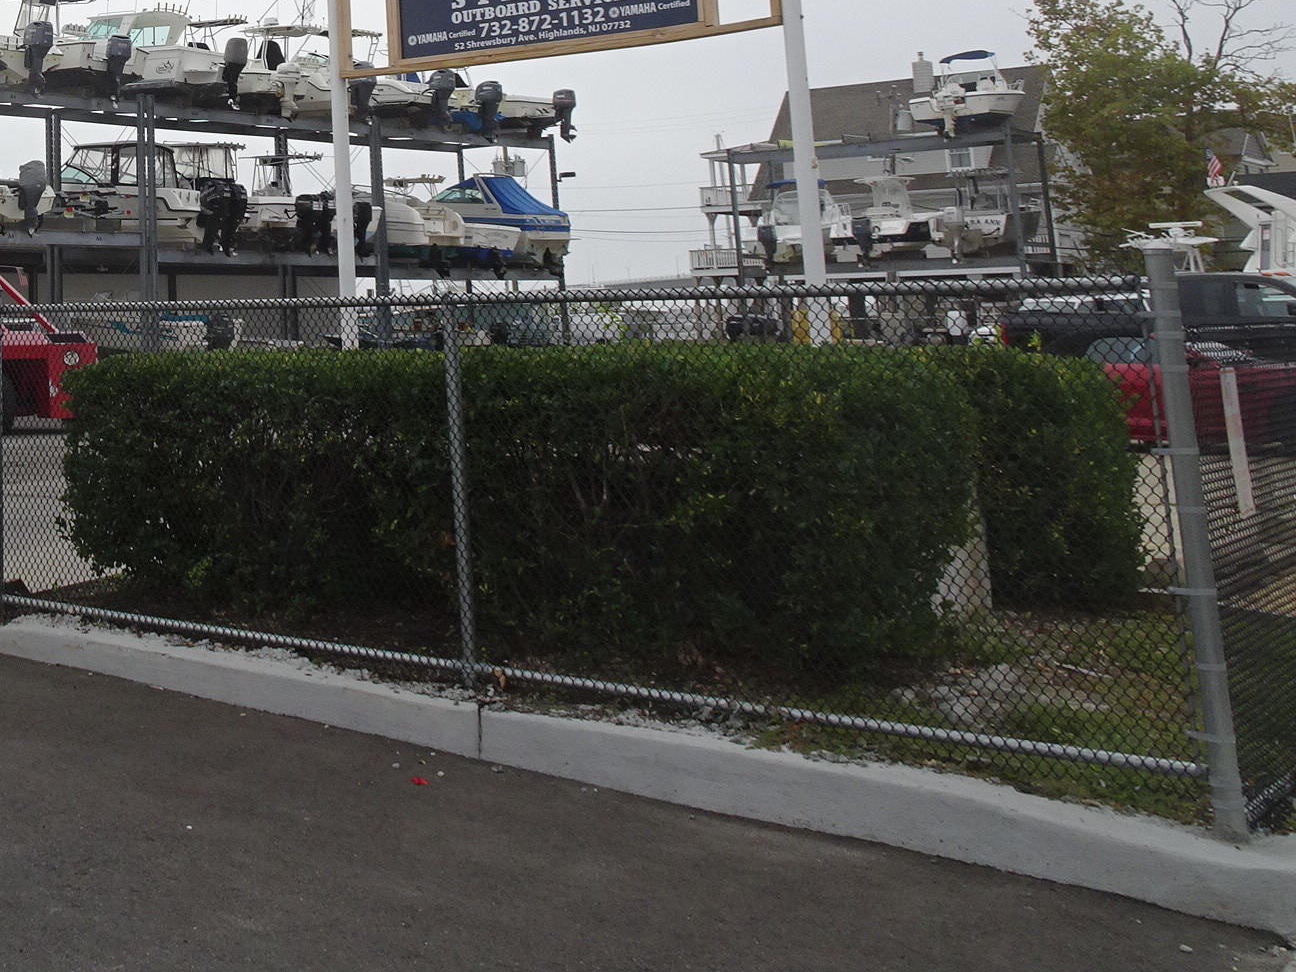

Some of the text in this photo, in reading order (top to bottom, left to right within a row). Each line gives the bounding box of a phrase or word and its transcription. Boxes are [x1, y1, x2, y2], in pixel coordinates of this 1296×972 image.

[451, 0, 541, 24] OUTBOARD
[618, 0, 691, 17] YAMAHA Certified
[478, 7, 606, 38] 732-872-1132
[416, 28, 476, 45] YAMAHA Certified
[466, 36, 517, 50] Shrewsbury
[518, 33, 537, 42] Ave.
[538, 27, 588, 41] Highlands,
[588, 24, 601, 34] NJ
[601, 20, 631, 31] 07732
